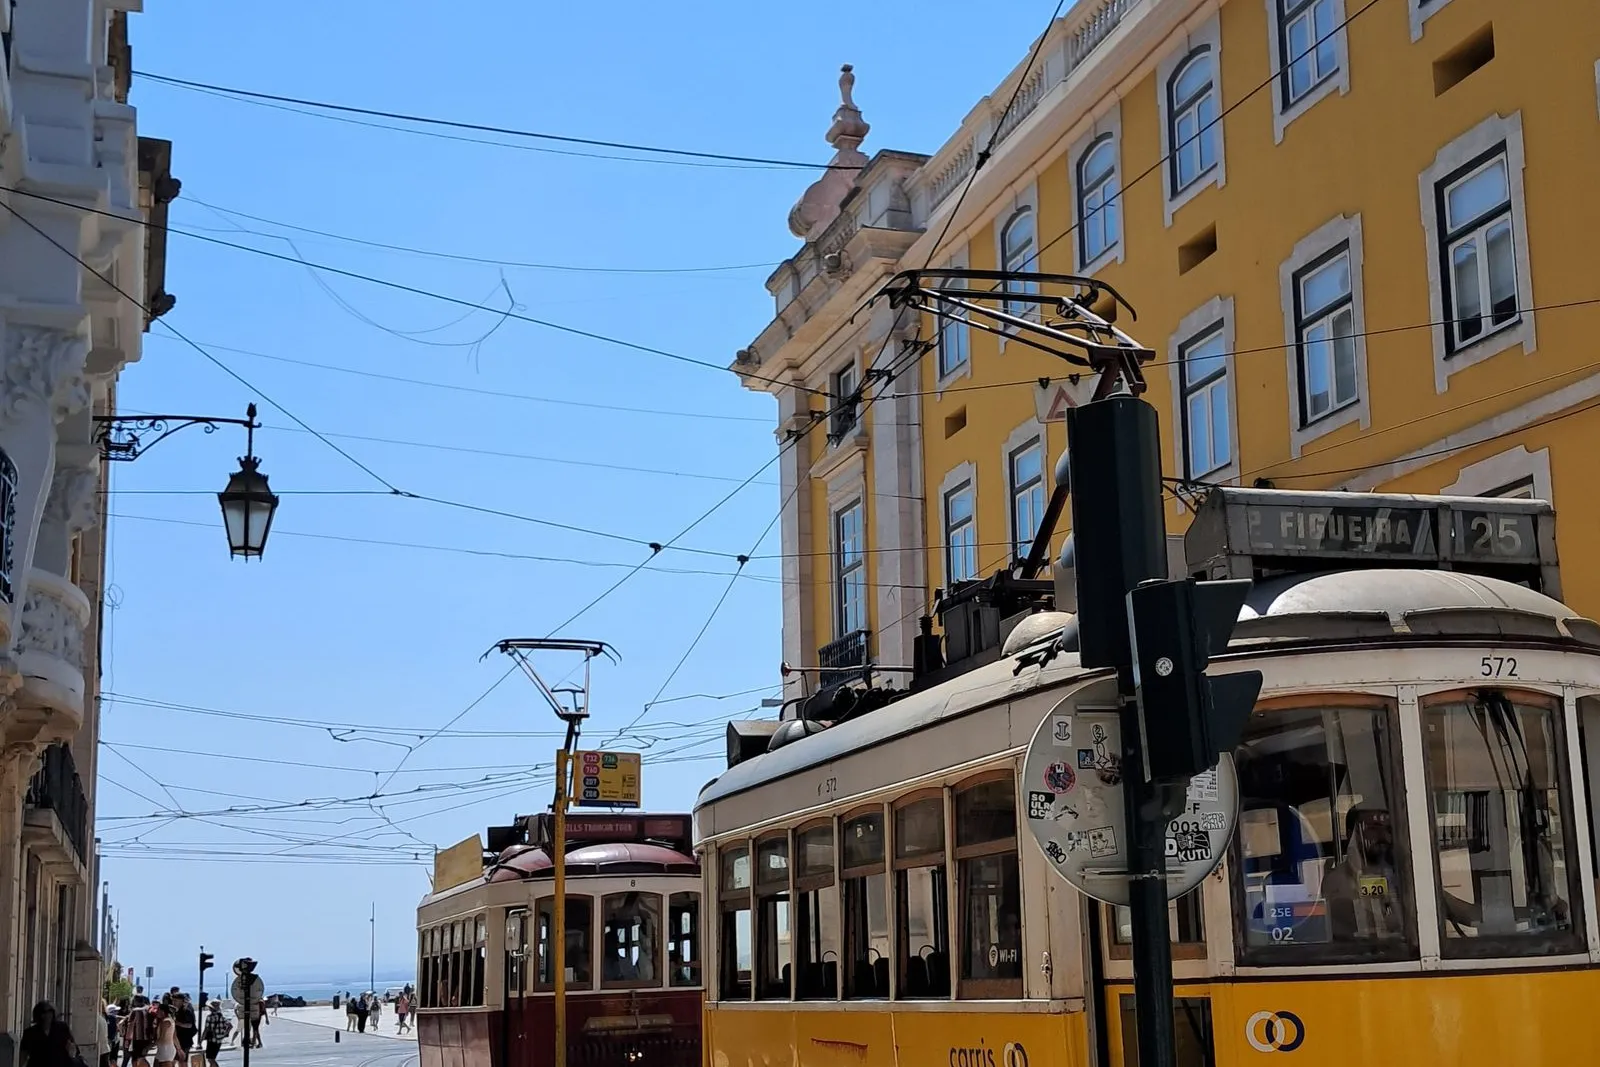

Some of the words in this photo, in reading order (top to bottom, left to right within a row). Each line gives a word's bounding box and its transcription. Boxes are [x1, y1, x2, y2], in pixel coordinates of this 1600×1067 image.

[1279, 511, 1412, 545] FIGUEIRA
[1470, 516, 1522, 555] 25
[1481, 656, 1518, 677] 572
[826, 777, 837, 793] 572
[1170, 820, 1200, 832] 003
[1178, 848, 1211, 862] KUTU
[630, 879, 636, 887] 8
[1270, 907, 1292, 918] 25E
[1271, 927, 1294, 941] 02
[999, 948, 1017, 963] WI-FI
[949, 1037, 996, 1067] carris
